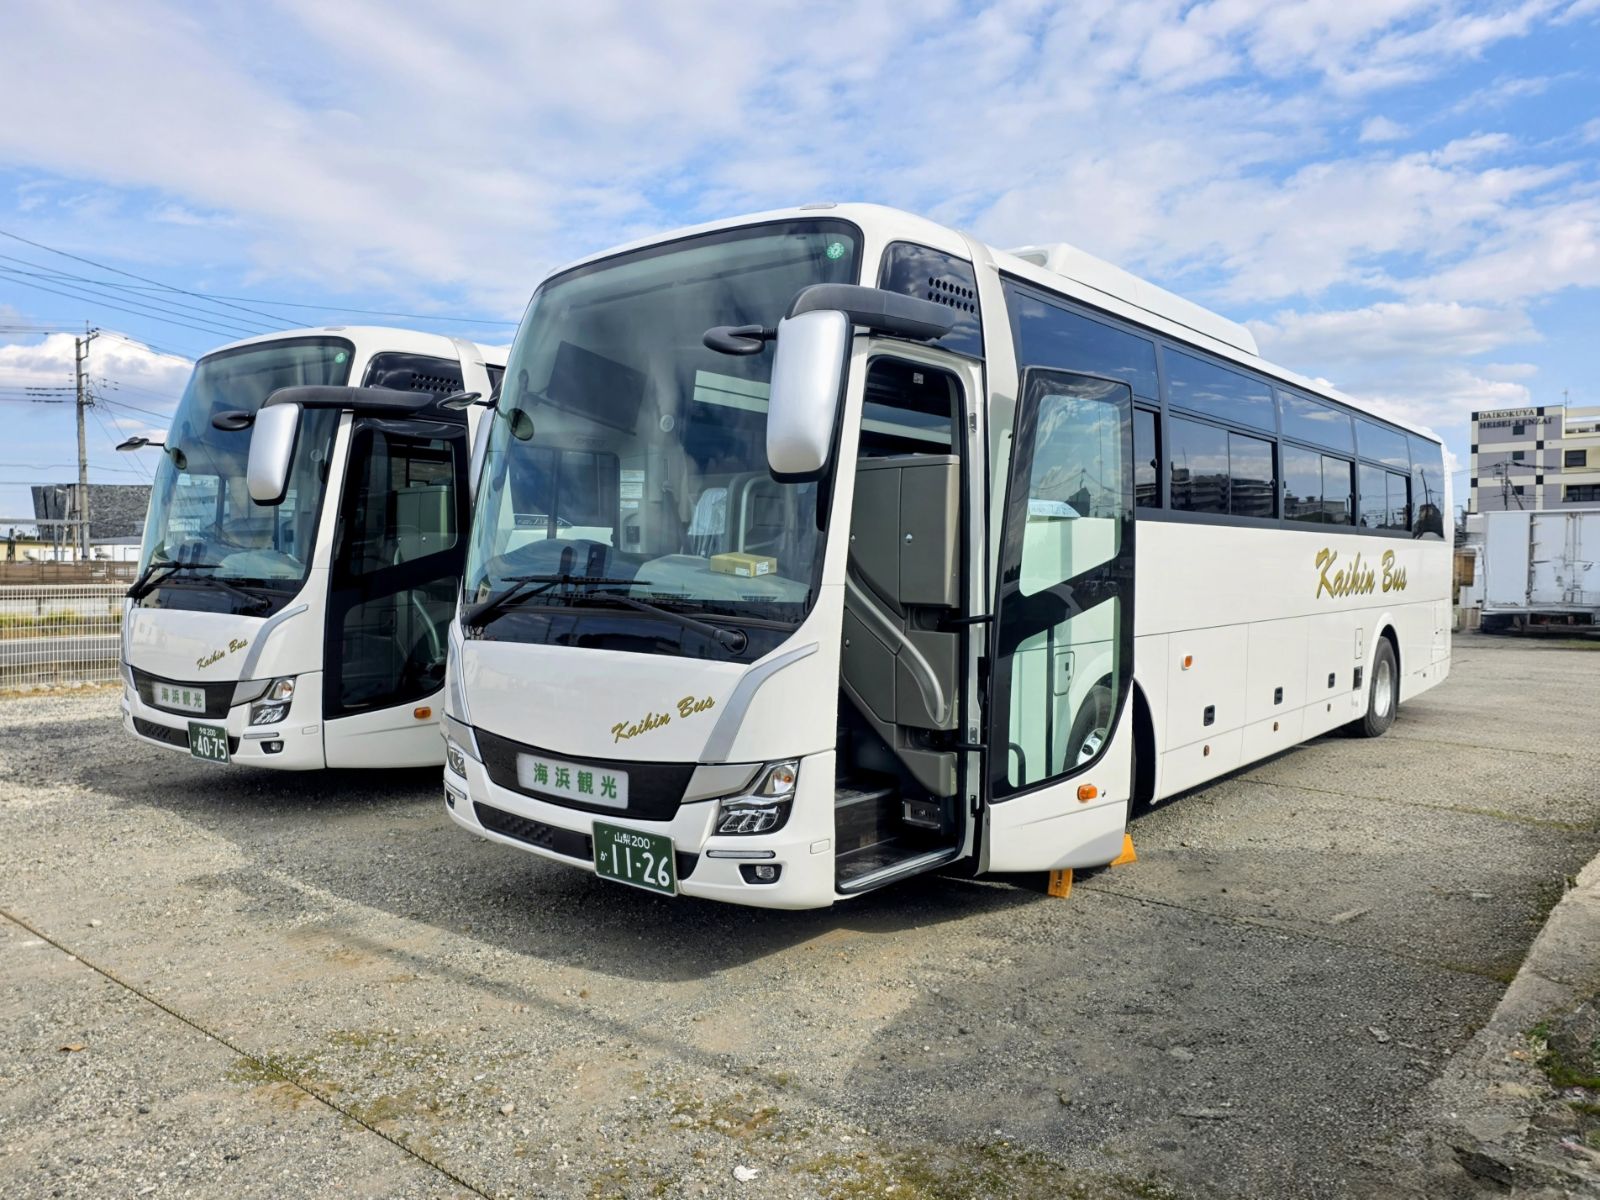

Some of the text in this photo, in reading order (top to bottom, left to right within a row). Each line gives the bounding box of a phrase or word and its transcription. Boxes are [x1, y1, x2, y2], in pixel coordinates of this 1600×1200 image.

[1480, 409, 1534, 419] DAIKOKUYA
[1315, 547, 1408, 600] Kaihin Bus
[196, 638, 248, 670] Kaihin Bus
[611, 695, 715, 744] Kaihin Bus
[197, 735, 227, 760] 40-75
[533, 761, 618, 799] 海浜観光
[611, 843, 671, 888] 11-26
